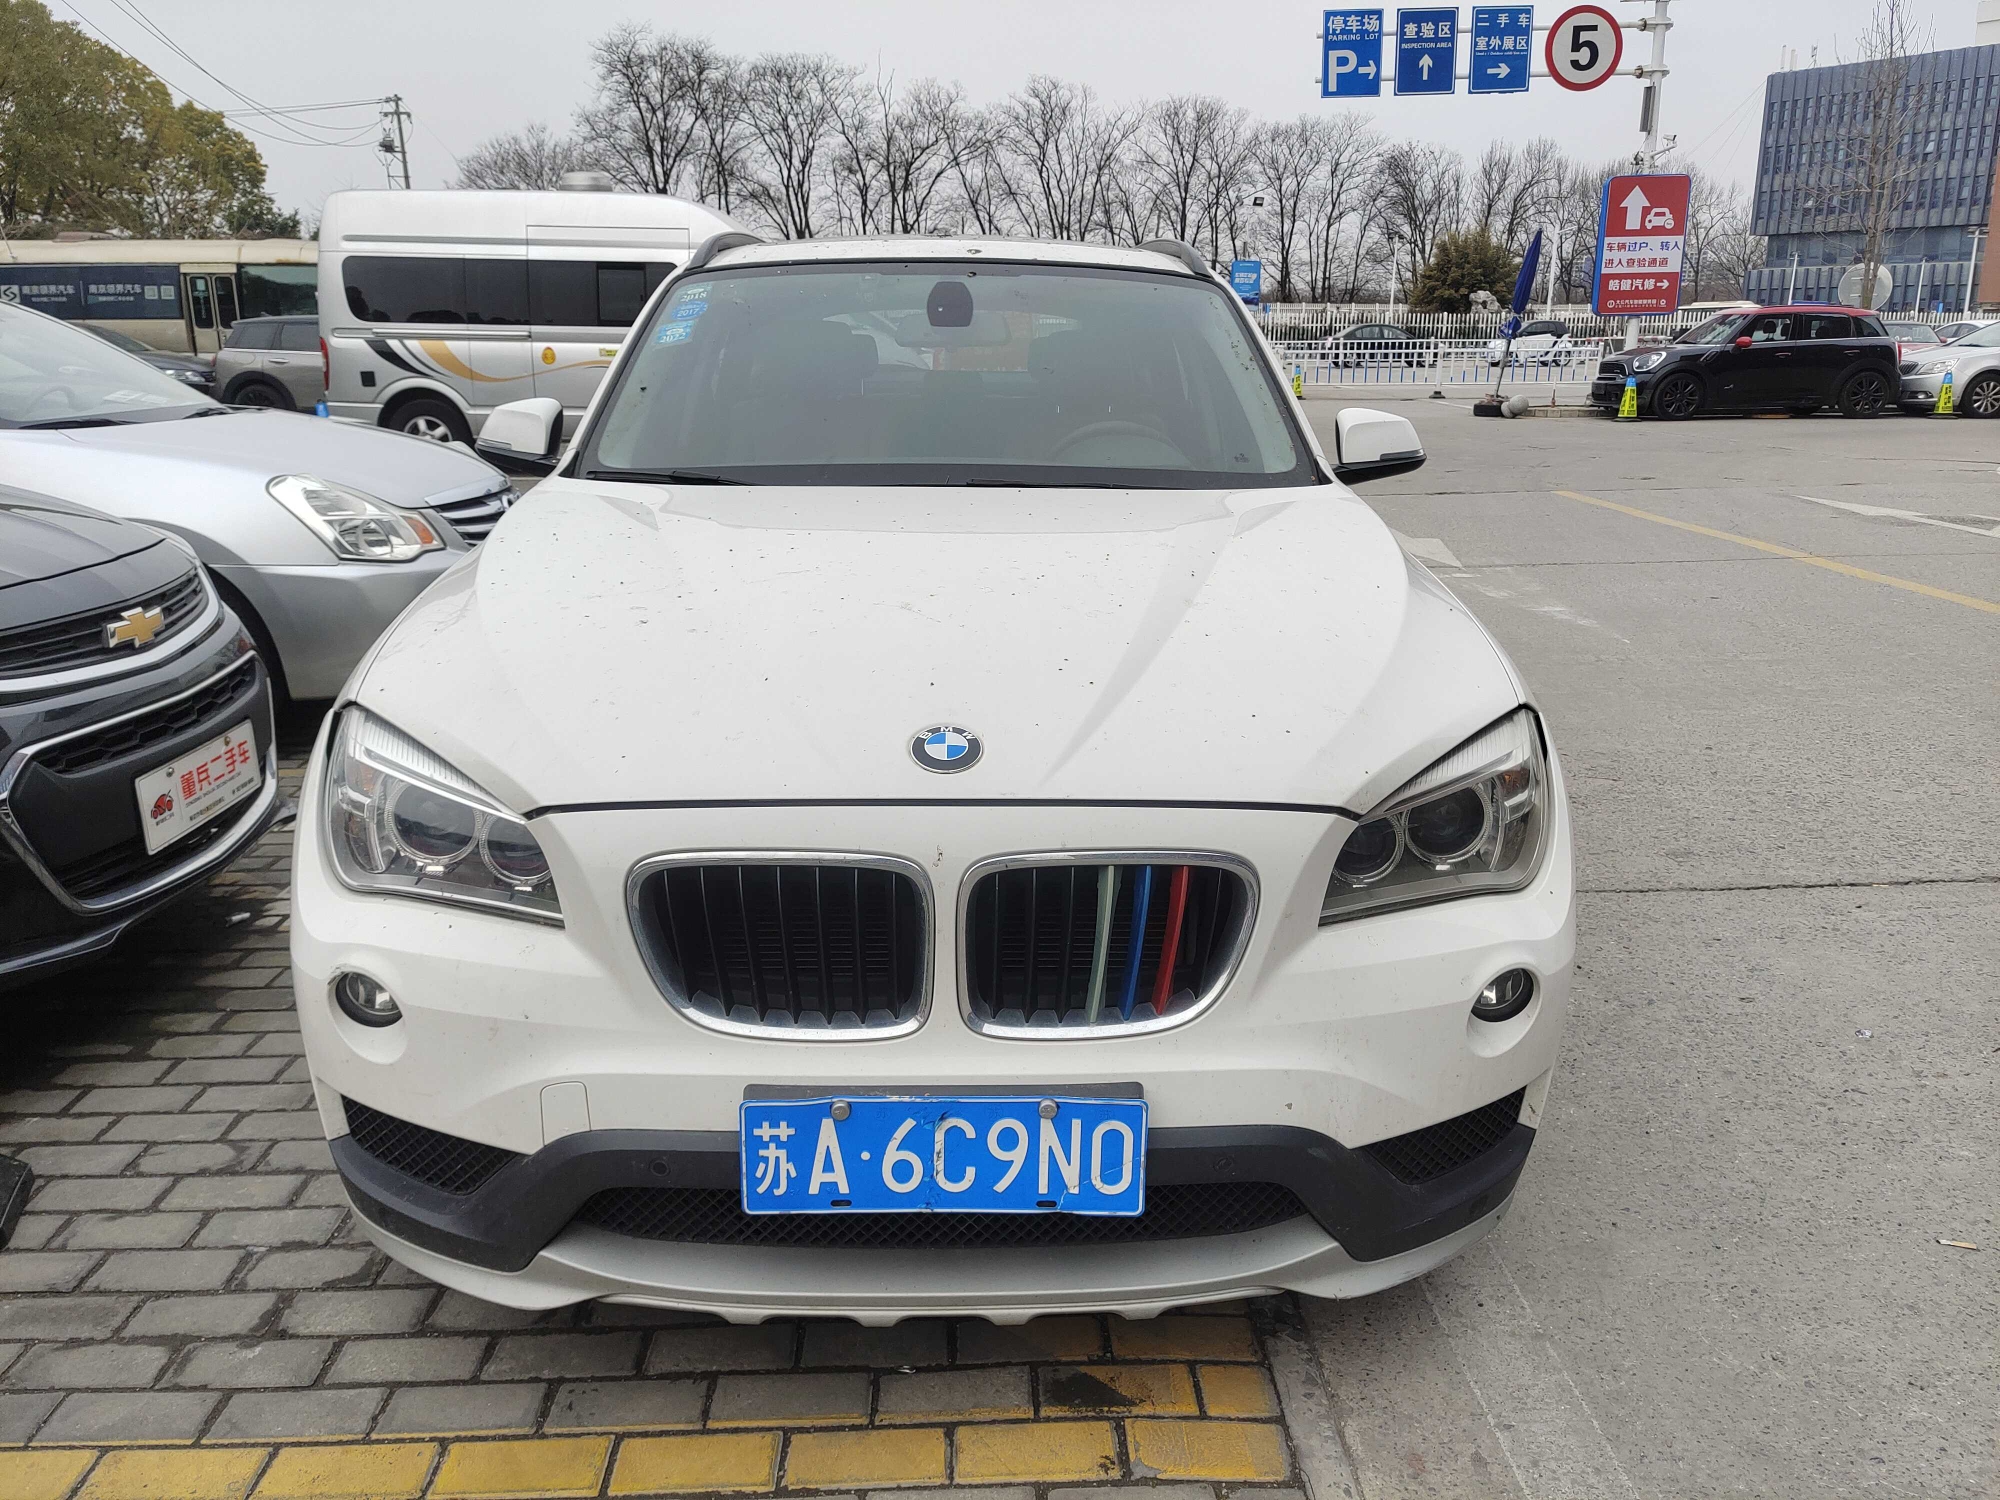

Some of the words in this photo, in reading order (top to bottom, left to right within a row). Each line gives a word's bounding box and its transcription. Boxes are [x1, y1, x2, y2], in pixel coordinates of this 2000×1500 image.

[1327, 14, 1380, 34] 停车场
[1477, 13, 1530, 28] 二手车
[1403, 21, 1452, 39] 查验区
[1328, 34, 1361, 42] PARKING
[1475, 35, 1528, 51] 室外展区
[1569, 24, 1600, 72] 5
[1328, 49, 1358, 92] P
[1608, 279, 1656, 291] 皓健汽修
[680, 291, 707, 301] 2018
[677, 308, 699, 317] 2017
[660, 333, 686, 342] 2022
[918, 726, 977, 740] BMW
